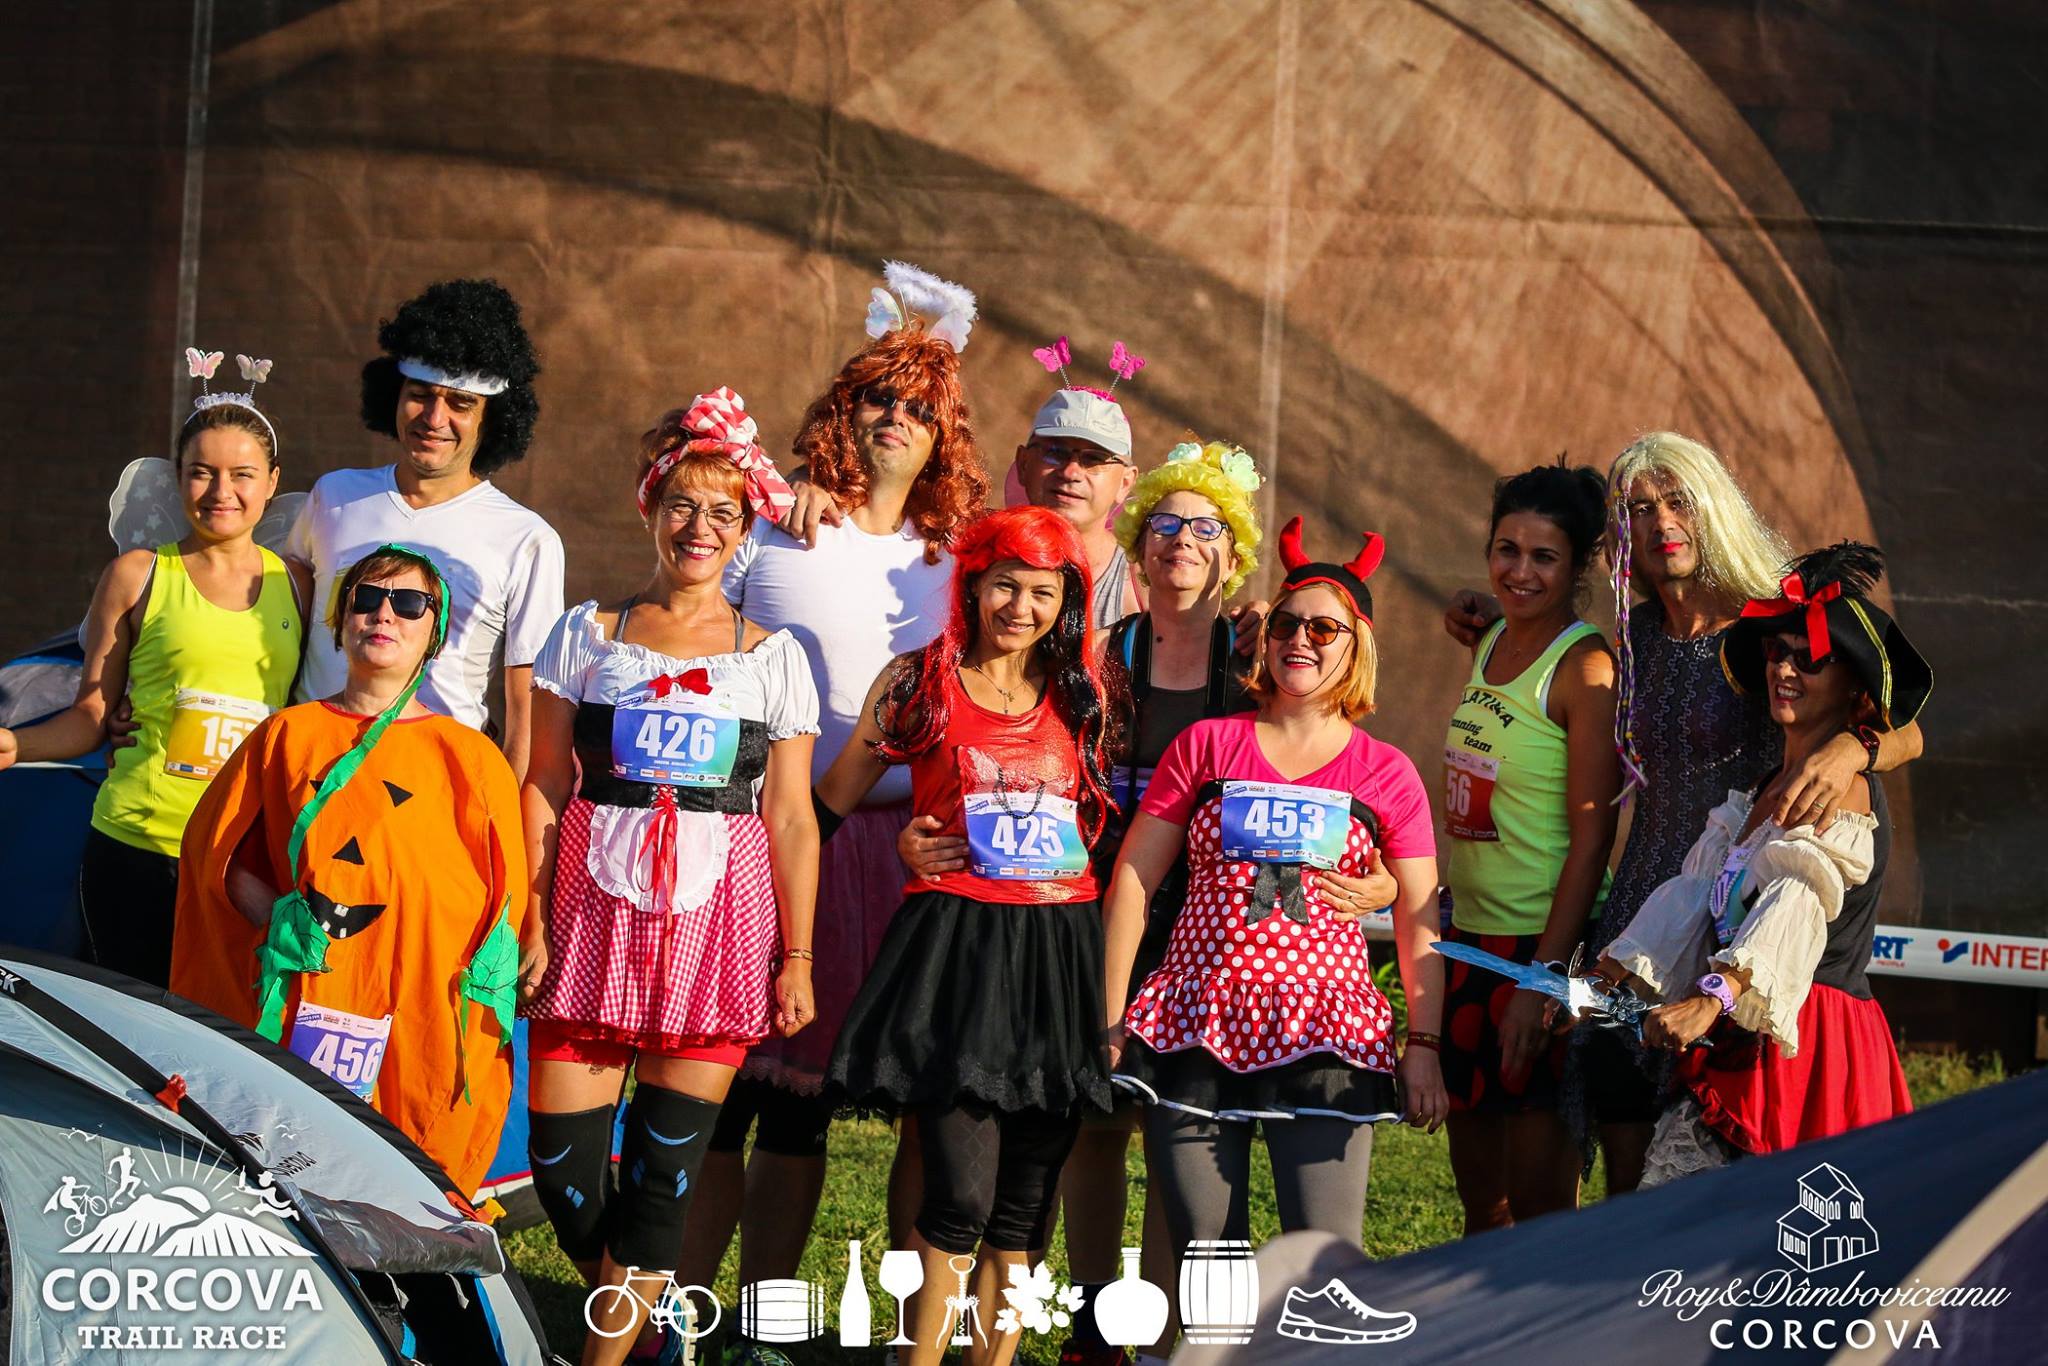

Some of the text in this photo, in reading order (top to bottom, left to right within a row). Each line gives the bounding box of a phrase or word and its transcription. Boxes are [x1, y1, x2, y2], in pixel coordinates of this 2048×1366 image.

[201, 716, 256, 758] 15
[635, 713, 716, 763] 426
[1464, 735, 1492, 753] team
[1446, 769, 1472, 817] 56
[991, 816, 1065, 858] 425
[1243, 798, 1326, 841] 453
[1872, 935, 1908, 960] RT
[309, 1032, 383, 1084] 456
